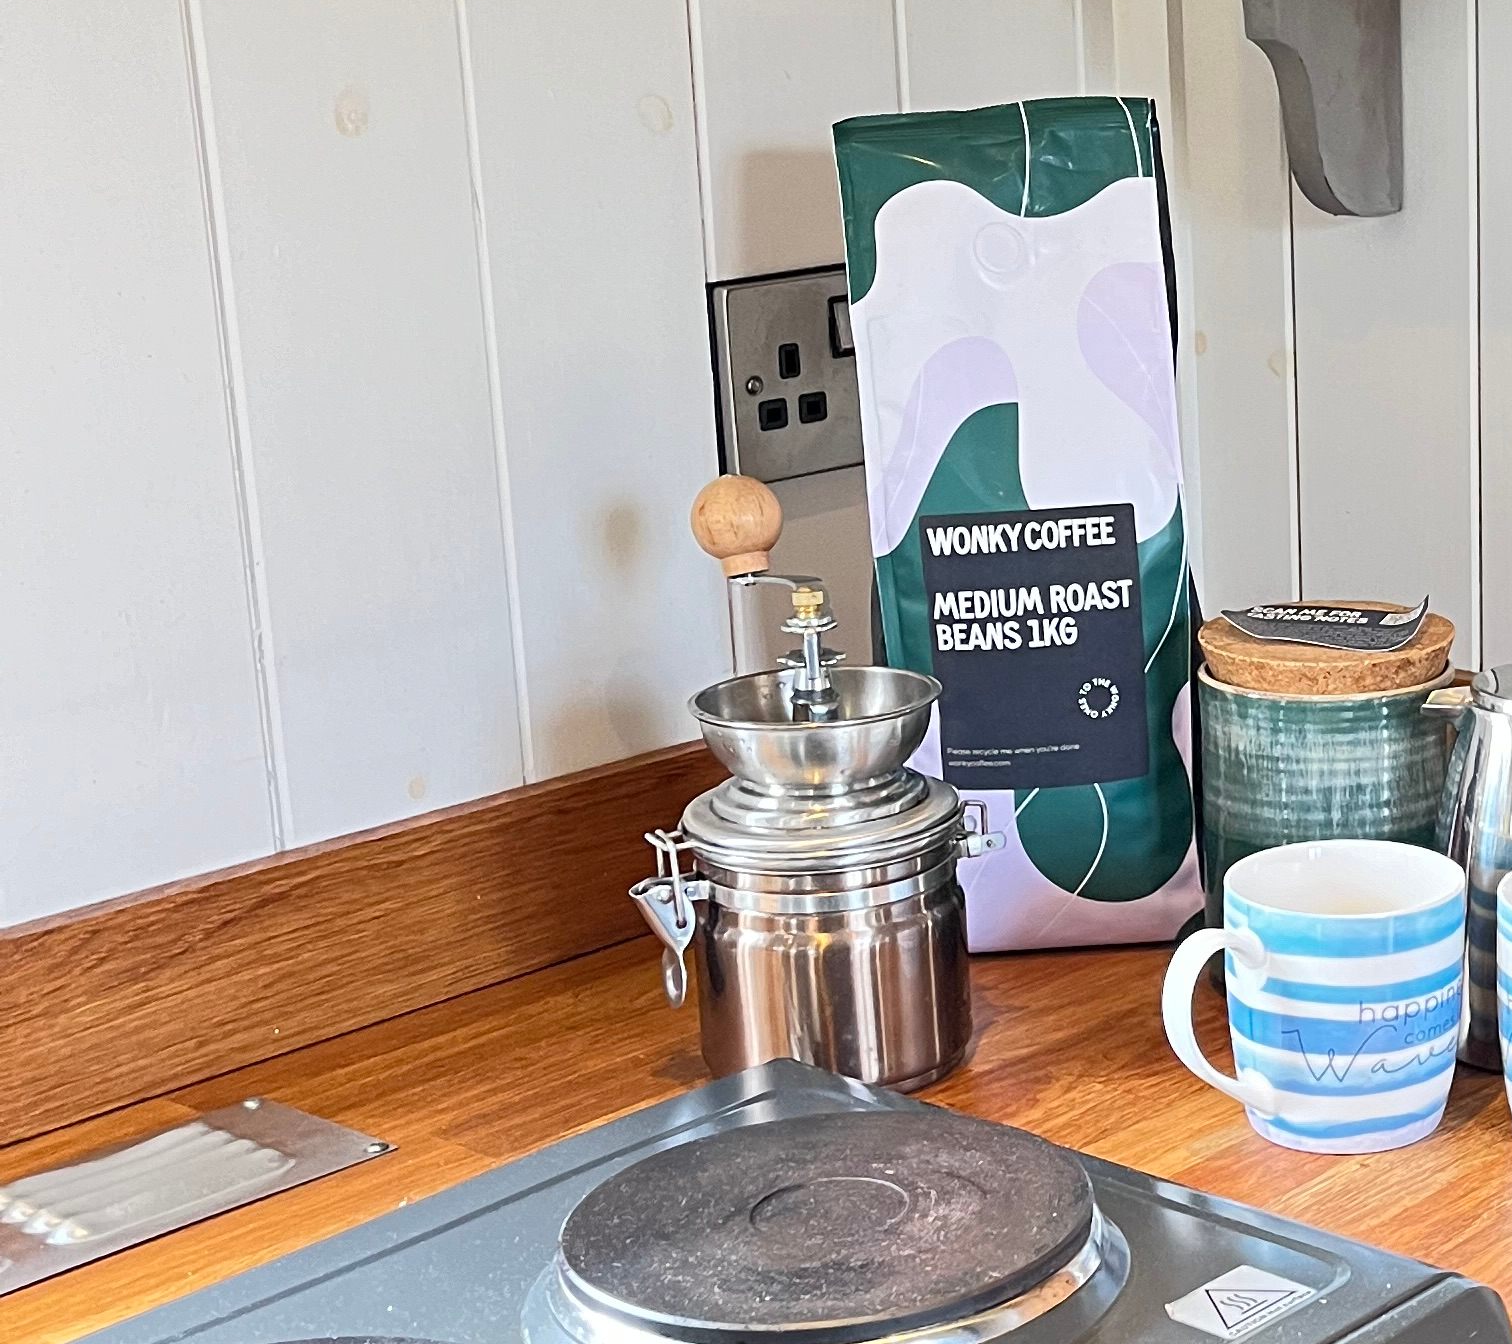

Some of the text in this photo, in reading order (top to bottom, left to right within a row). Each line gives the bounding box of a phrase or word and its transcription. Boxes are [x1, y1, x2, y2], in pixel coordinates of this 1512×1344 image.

[926, 516, 1116, 556] WONKY COFFEE
[933, 579, 1133, 620] MEDIUM ROAST
[1250, 607, 1298, 615] SCAN
[1328, 610, 1362, 619] FOR
[936, 617, 1078, 652] BEANS 1KG
[1314, 615, 1369, 624] NOTES
[1078, 677, 1120, 719] TO THE WONKY ONES
[1060, 743, 1080, 752] done
